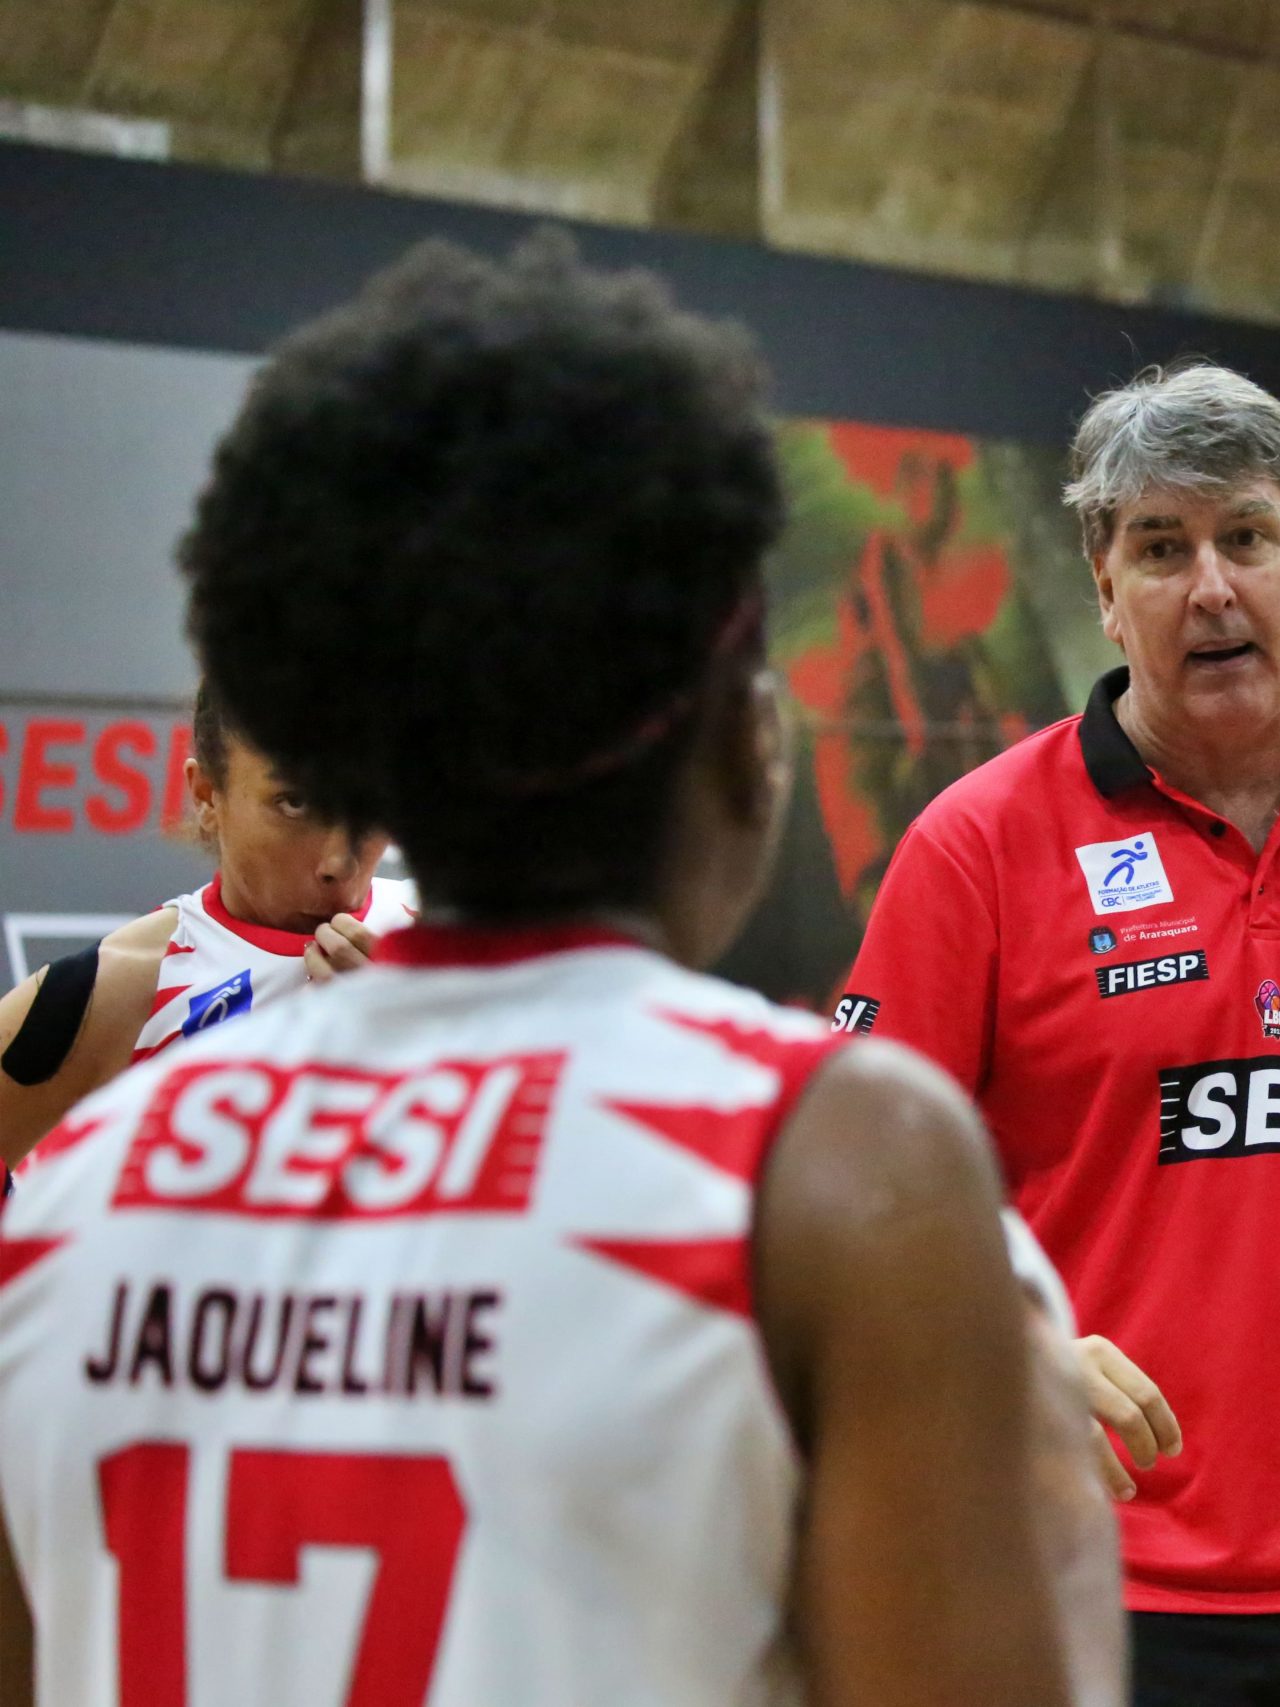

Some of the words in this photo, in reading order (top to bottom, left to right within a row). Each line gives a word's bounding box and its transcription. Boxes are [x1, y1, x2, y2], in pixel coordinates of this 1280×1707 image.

[0, 717, 194, 834] ESI
[1101, 896, 1122, 907] CBC
[1120, 922, 1159, 934] Prefeitura
[1123, 933, 1137, 942] de
[1139, 924, 1198, 940] Araraquara
[1108, 954, 1199, 993] FIESP
[143, 1064, 524, 1211] SESI
[97, 1443, 469, 1707] 17
